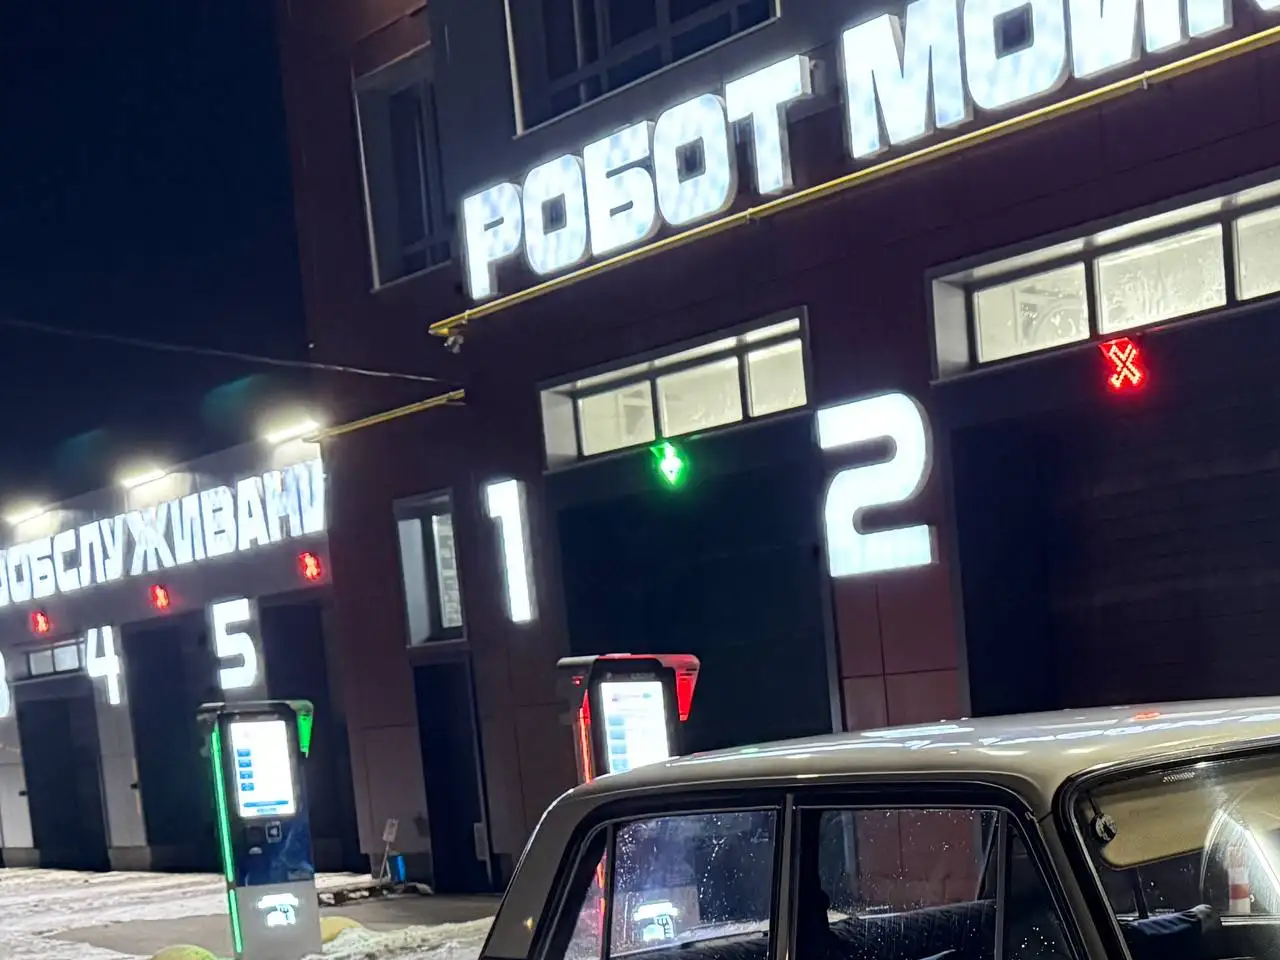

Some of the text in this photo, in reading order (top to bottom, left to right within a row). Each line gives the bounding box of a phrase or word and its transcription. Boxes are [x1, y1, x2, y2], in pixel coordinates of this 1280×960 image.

[463, 54, 809, 300] РОБОТ
[487, 479, 534, 623] 1
[818, 392, 934, 577] 2
[87, 625, 120, 705] 4
[212, 598, 258, 690] 5
